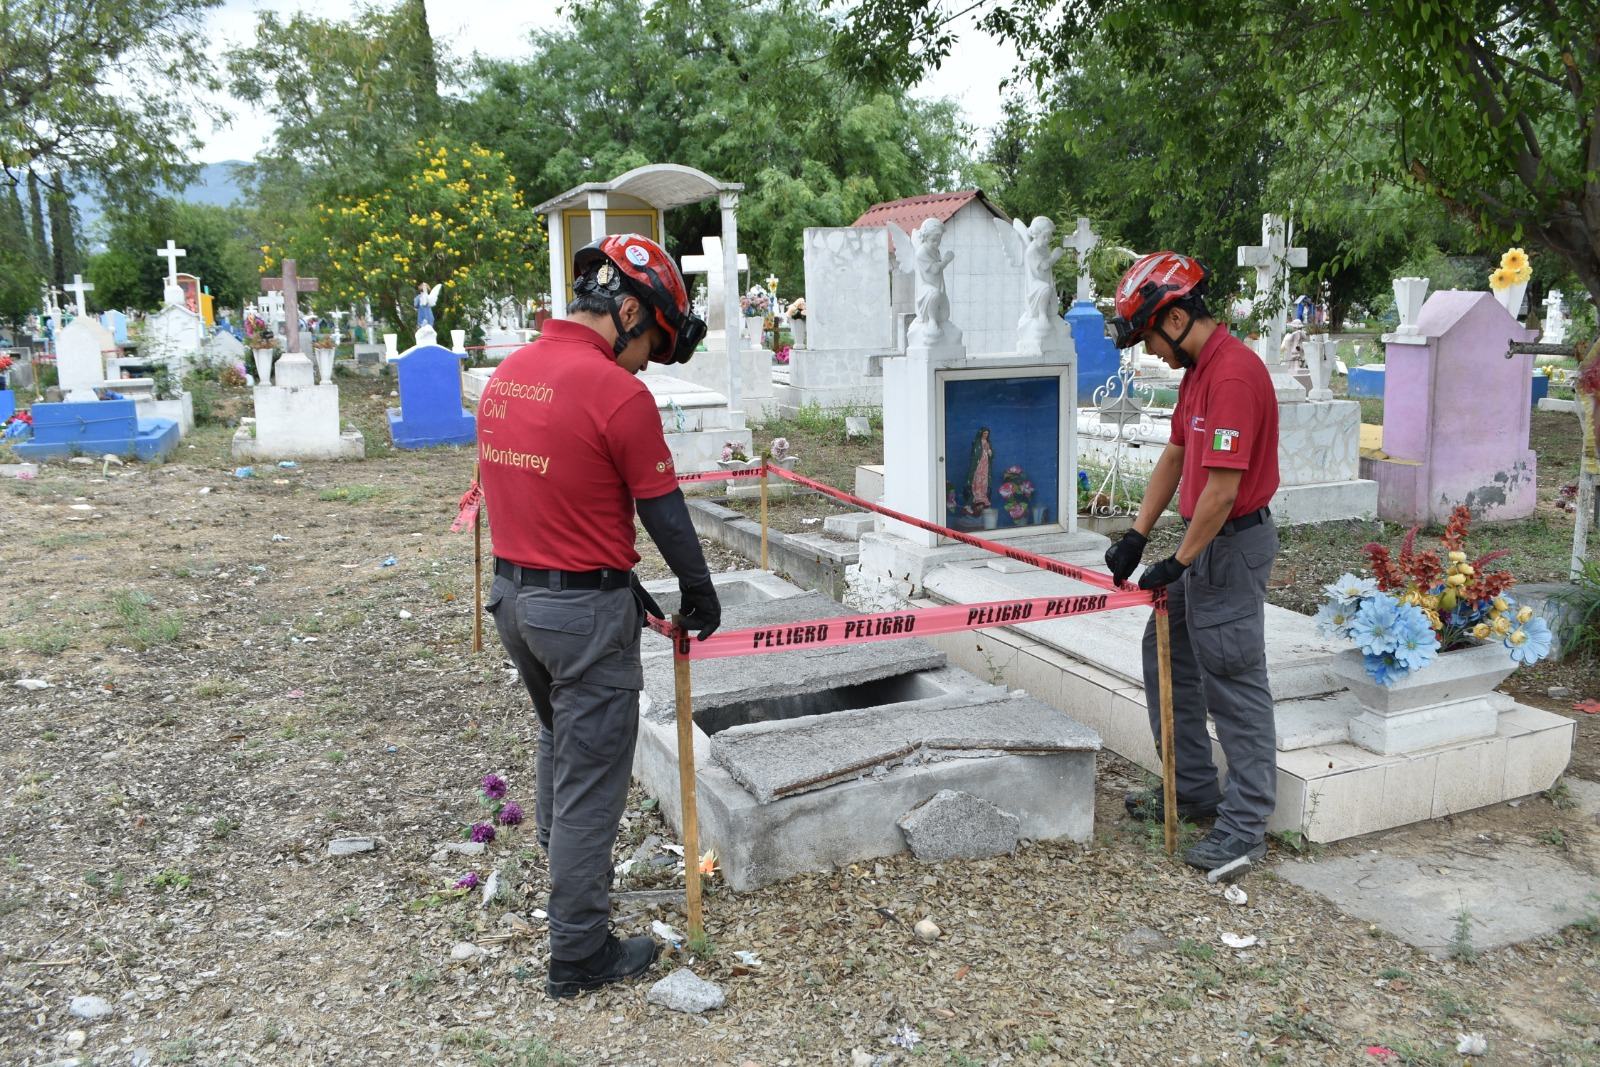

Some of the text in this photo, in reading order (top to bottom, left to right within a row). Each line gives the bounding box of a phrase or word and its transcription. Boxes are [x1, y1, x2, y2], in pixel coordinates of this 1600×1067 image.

[488, 377, 554, 403] Protección
[482, 398, 508, 420] Civil
[481, 441, 550, 475] Monterrey
[753, 594, 1108, 648] PELIGRO PELIGRO PELIGRO PELIGRO
